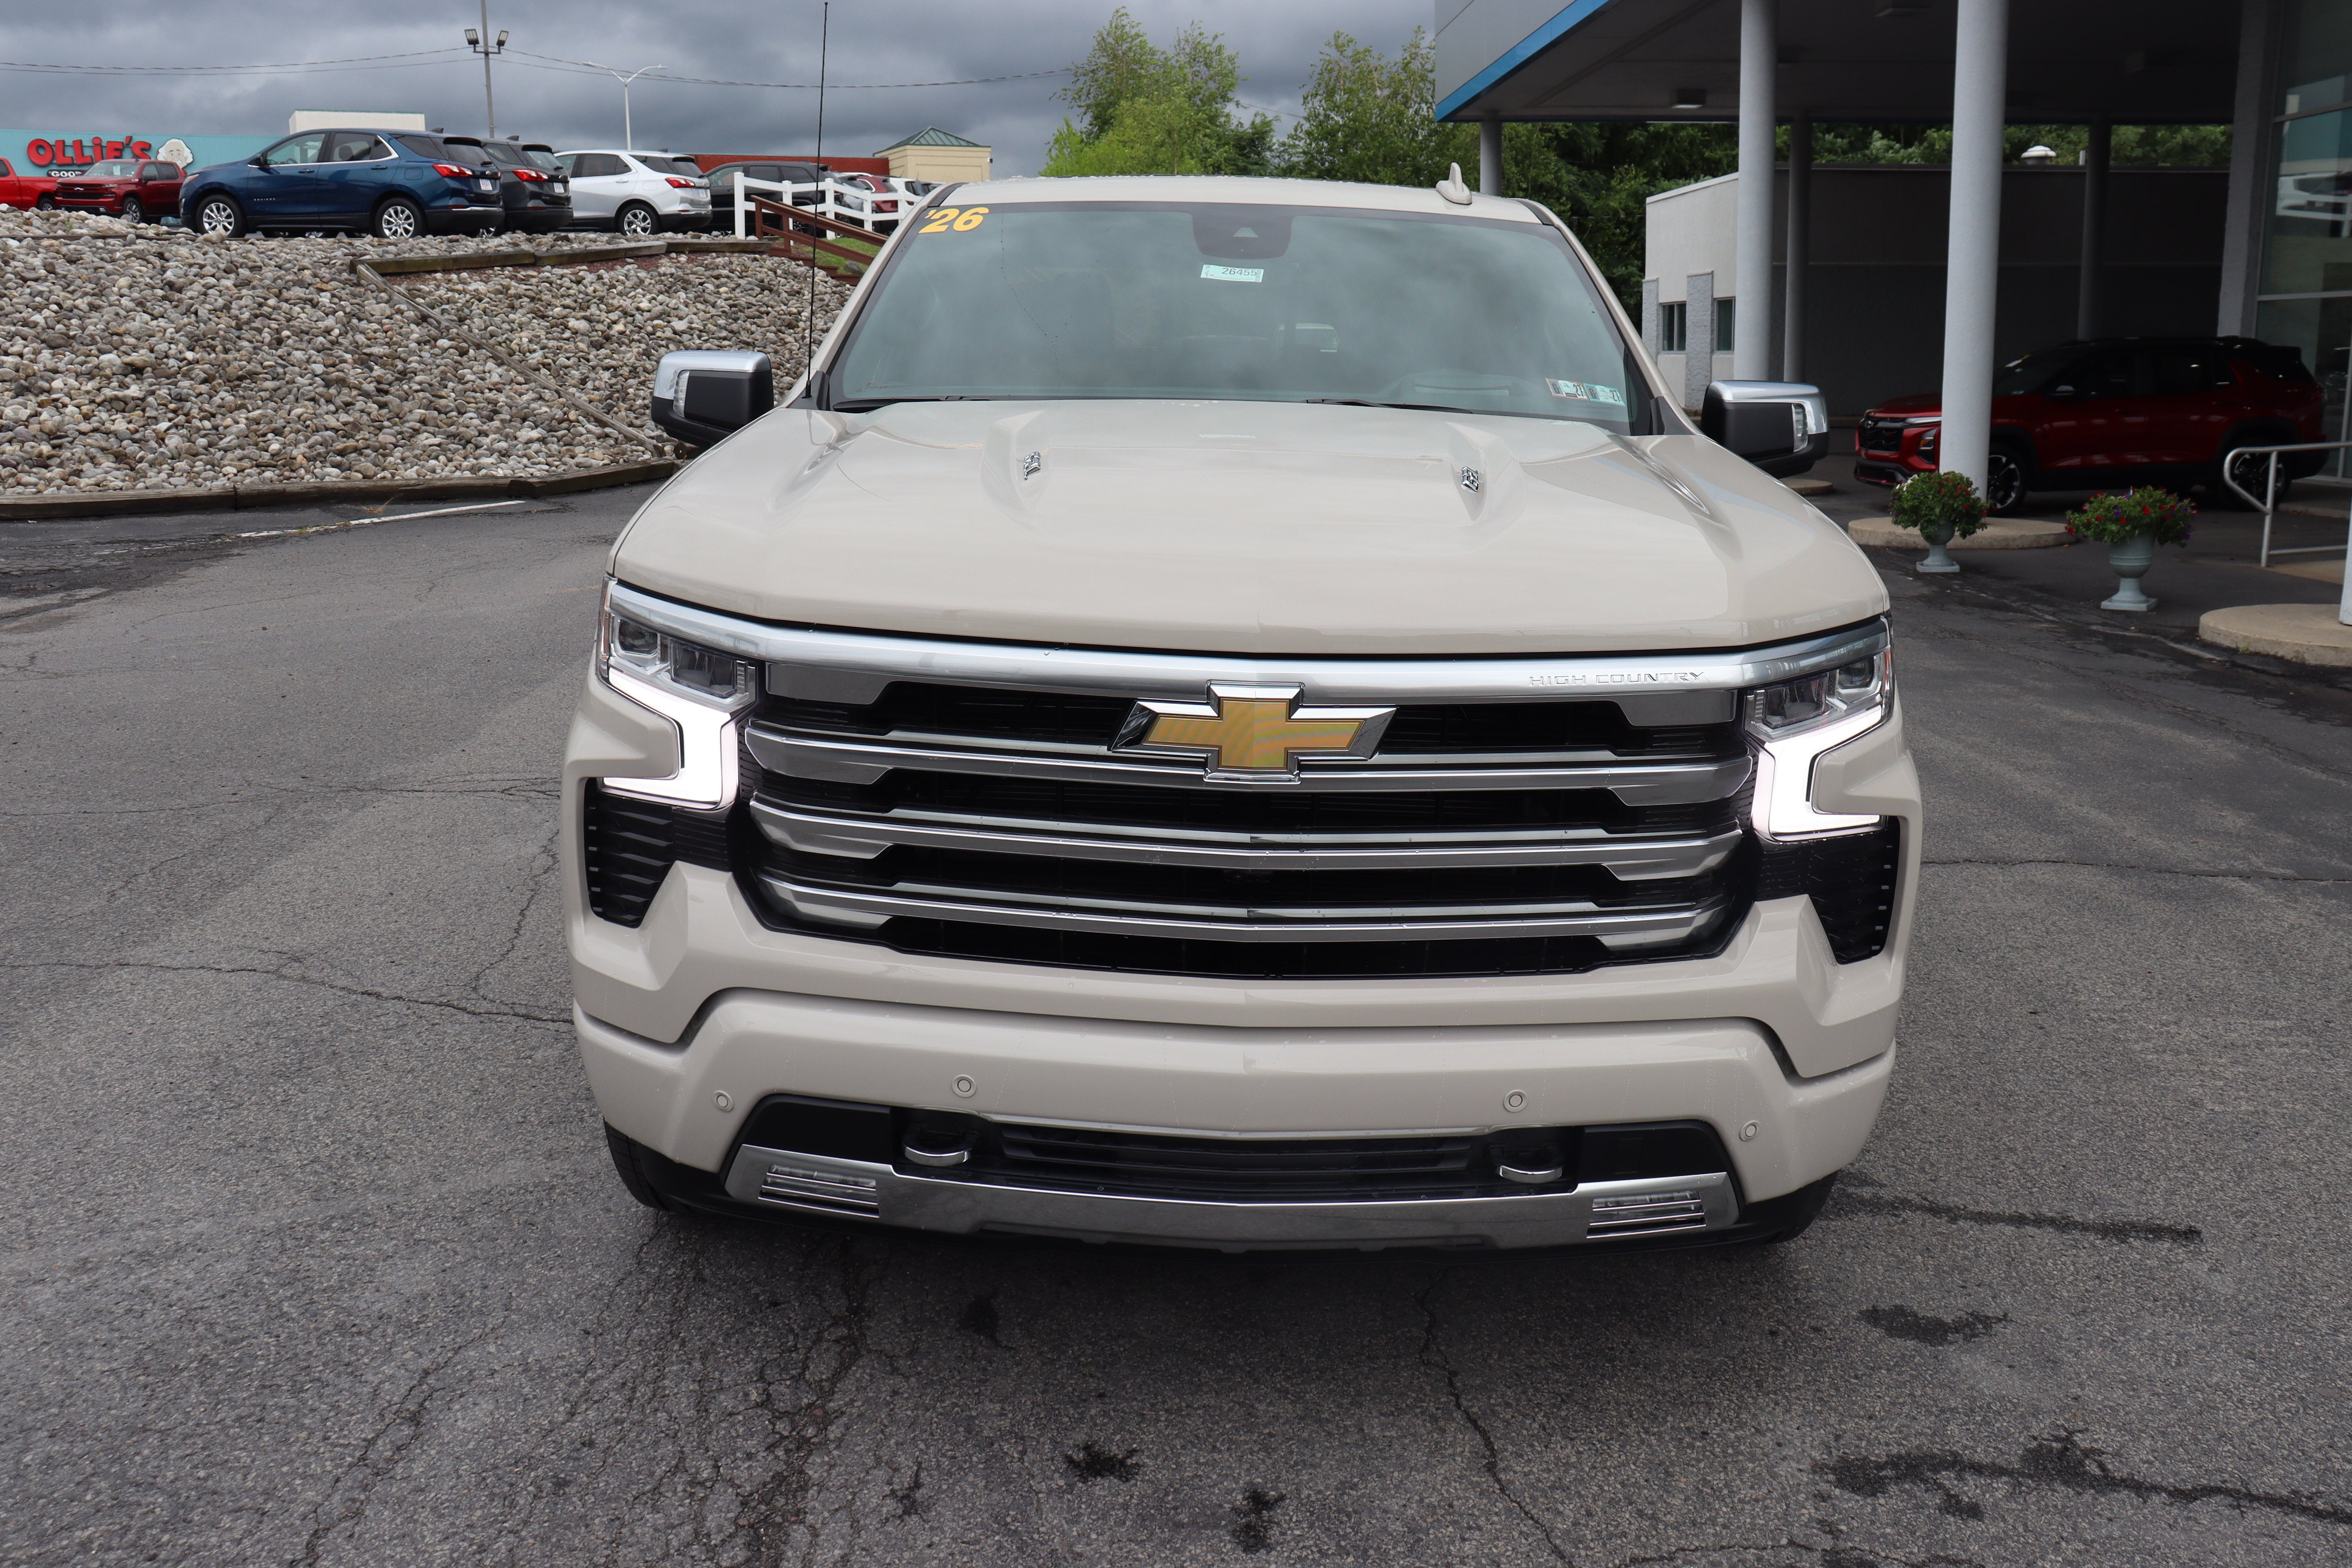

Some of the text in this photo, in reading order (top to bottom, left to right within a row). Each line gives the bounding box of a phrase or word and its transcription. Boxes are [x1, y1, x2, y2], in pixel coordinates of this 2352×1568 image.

[918, 207, 989, 234] '26
[1221, 267, 1257, 276] 26455
[1572, 384, 1584, 398] 27
[1529, 672, 1704, 686] HIGH COUNTRY
